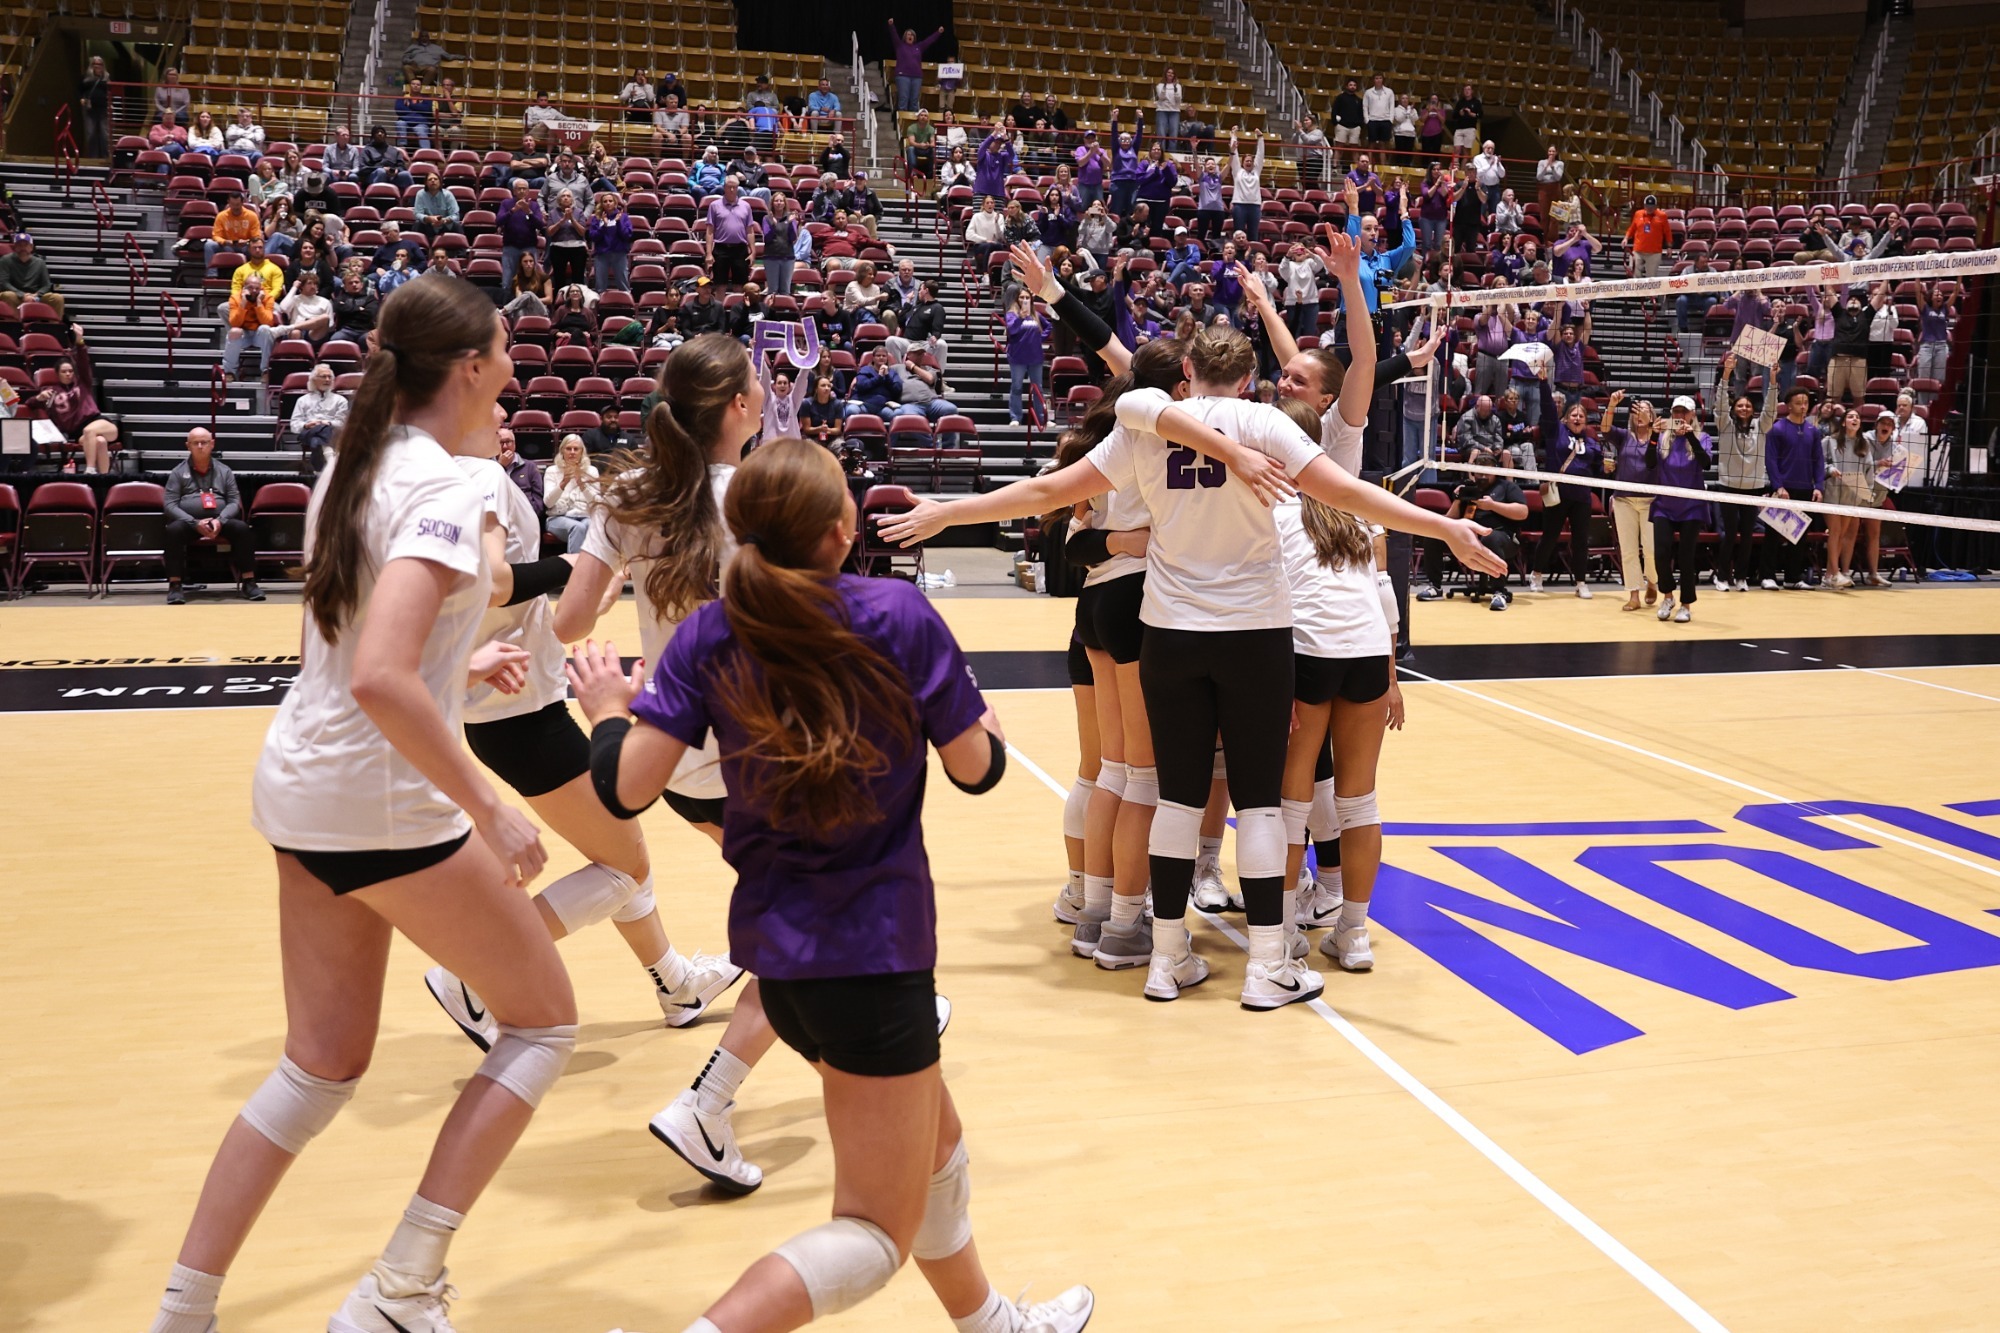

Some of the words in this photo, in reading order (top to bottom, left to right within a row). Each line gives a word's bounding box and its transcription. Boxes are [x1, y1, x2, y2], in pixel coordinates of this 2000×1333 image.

[557, 122, 588, 130] SECTION
[565, 131, 581, 140] 101
[1852, 262, 1879, 276] SOUTHERN
[1879, 260, 1915, 274] CONFERENCE
[1915, 257, 1950, 271] VOLLEYBALL
[1951, 254, 1998, 269] CHAMPIONSHIP
[1697, 277, 1720, 286] SOUTHERN
[1745, 272, 1772, 283] VOLLEYBALL
[1772, 270, 1807, 281] CHAMPIONSHIP
[751, 315, 820, 377] FU
[417, 517, 462, 545] SOCON
